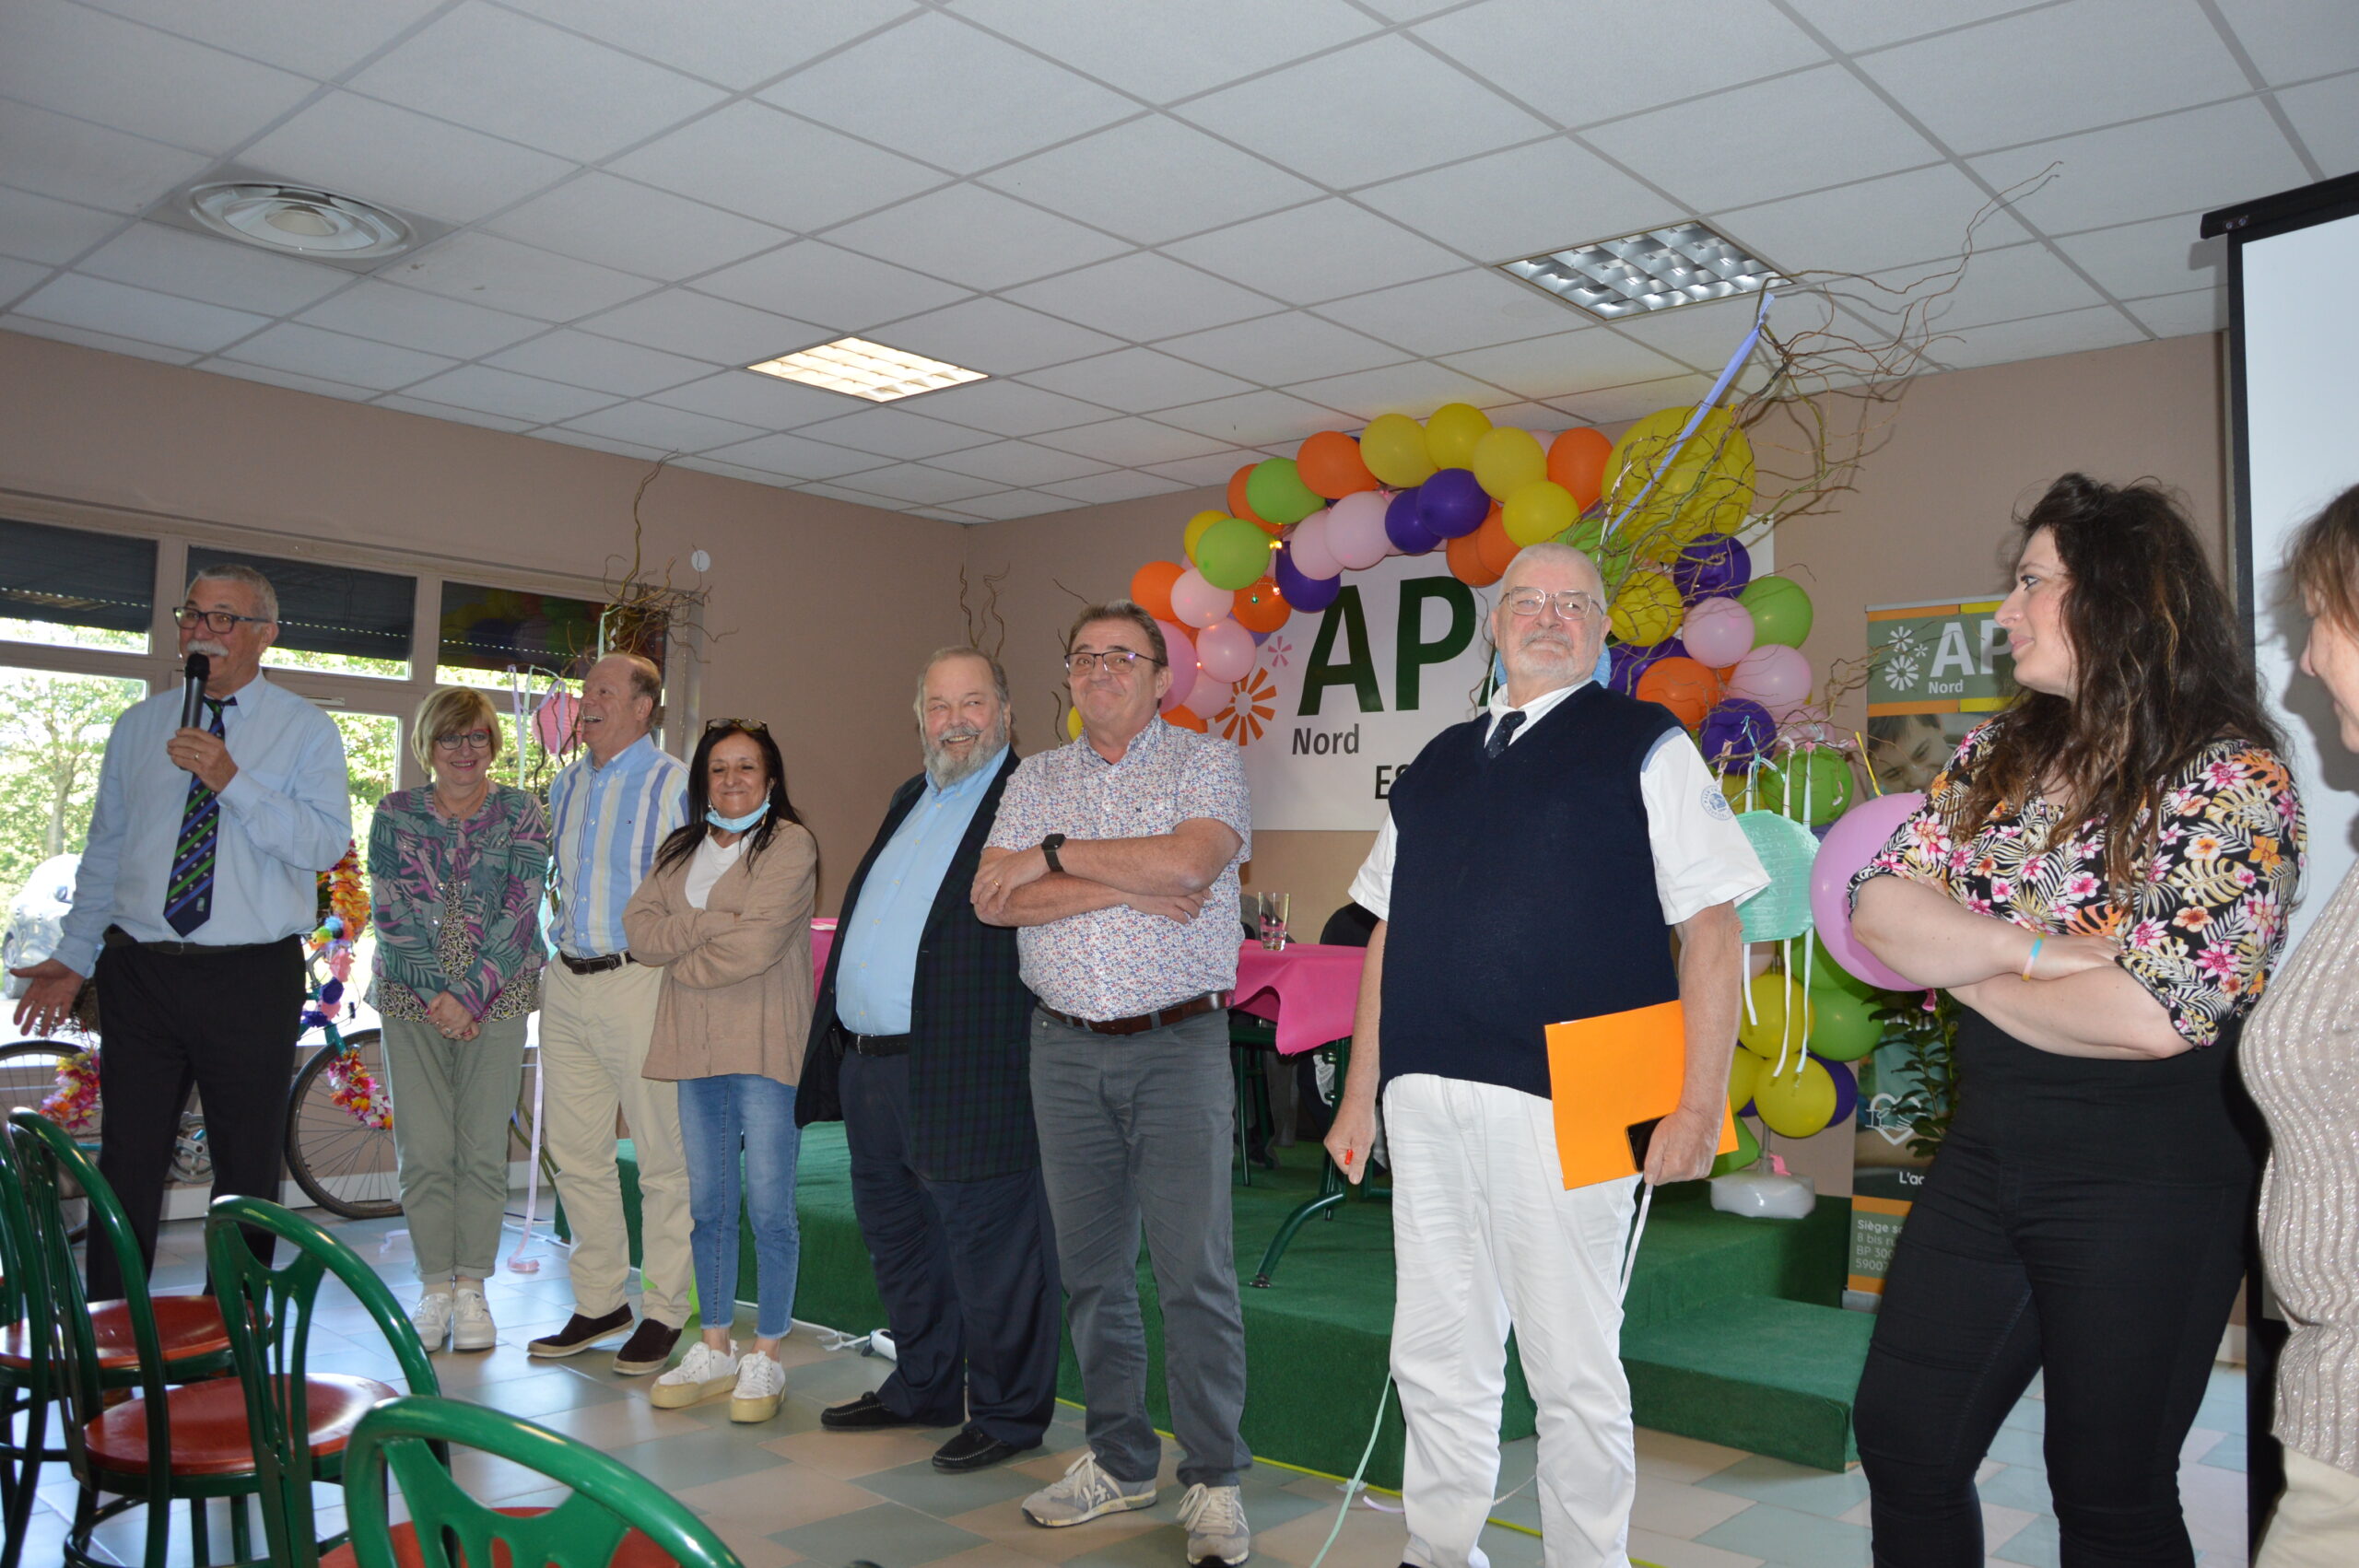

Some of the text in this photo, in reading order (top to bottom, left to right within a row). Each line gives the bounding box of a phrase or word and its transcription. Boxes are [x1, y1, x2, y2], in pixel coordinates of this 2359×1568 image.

[1297, 576, 1502, 716] AP
[1928, 679, 1964, 694] Nord
[1292, 723, 1359, 755] Nord
[1375, 764, 1410, 800] E
[1858, 1220, 1888, 1234] Siège
[1857, 1233, 1863, 1242] 8
[1867, 1234, 1883, 1246] bis
[1857, 1246, 1871, 1256] BP
